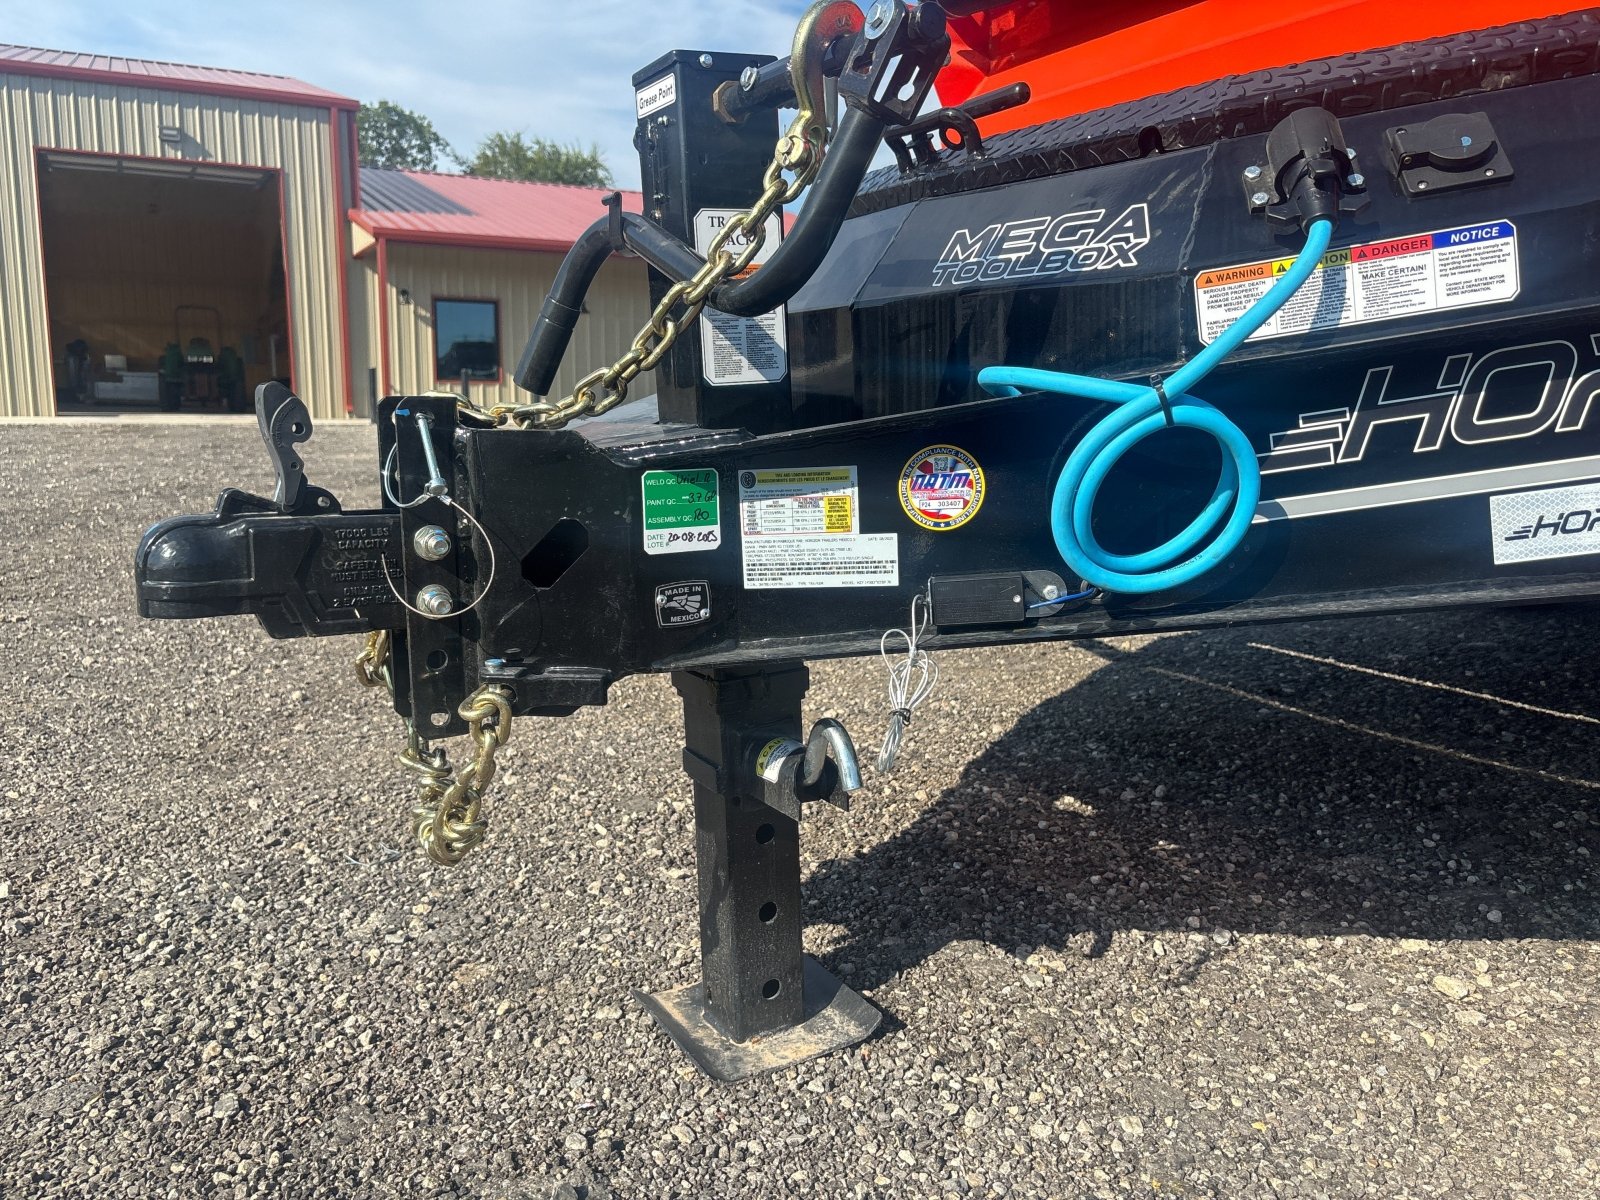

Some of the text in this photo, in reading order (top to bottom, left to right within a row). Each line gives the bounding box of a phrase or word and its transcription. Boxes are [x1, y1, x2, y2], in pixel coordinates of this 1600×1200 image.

[639, 83, 673, 110] Grease Point
[939, 203, 1150, 264] MEGA
[1450, 227, 1499, 243] NOTICE
[1372, 240, 1428, 256] DANGER
[932, 240, 1149, 287] TOOLBOX
[1361, 263, 1426, 280] MAKE CERTAIN!
[1216, 268, 1264, 282] WARNING
[1203, 286, 1226, 294] SERIOUS
[1248, 280, 1266, 288] DEATH
[1465, 280, 1494, 288] DEPARTMENT
[1206, 297, 1230, 305] DAMAGE
[1209, 287, 1258, 300] AND/OR PROPERTY
[1224, 300, 1244, 308] MISUSE
[911, 448, 956, 466] COMPLIANCE
[958, 452, 974, 468] WITH
[911, 473, 970, 490] NATM
[972, 468, 982, 491] NATM
[902, 478, 934, 527] MANUFACTURED
[950, 492, 982, 526] GUIDELINES
[648, 516, 681, 524] ASSEMBLY
[370, 527, 389, 537] LBS
[338, 539, 388, 550] CAPACITY
[664, 586, 690, 596] MADE
[670, 612, 700, 622] MEXICO
